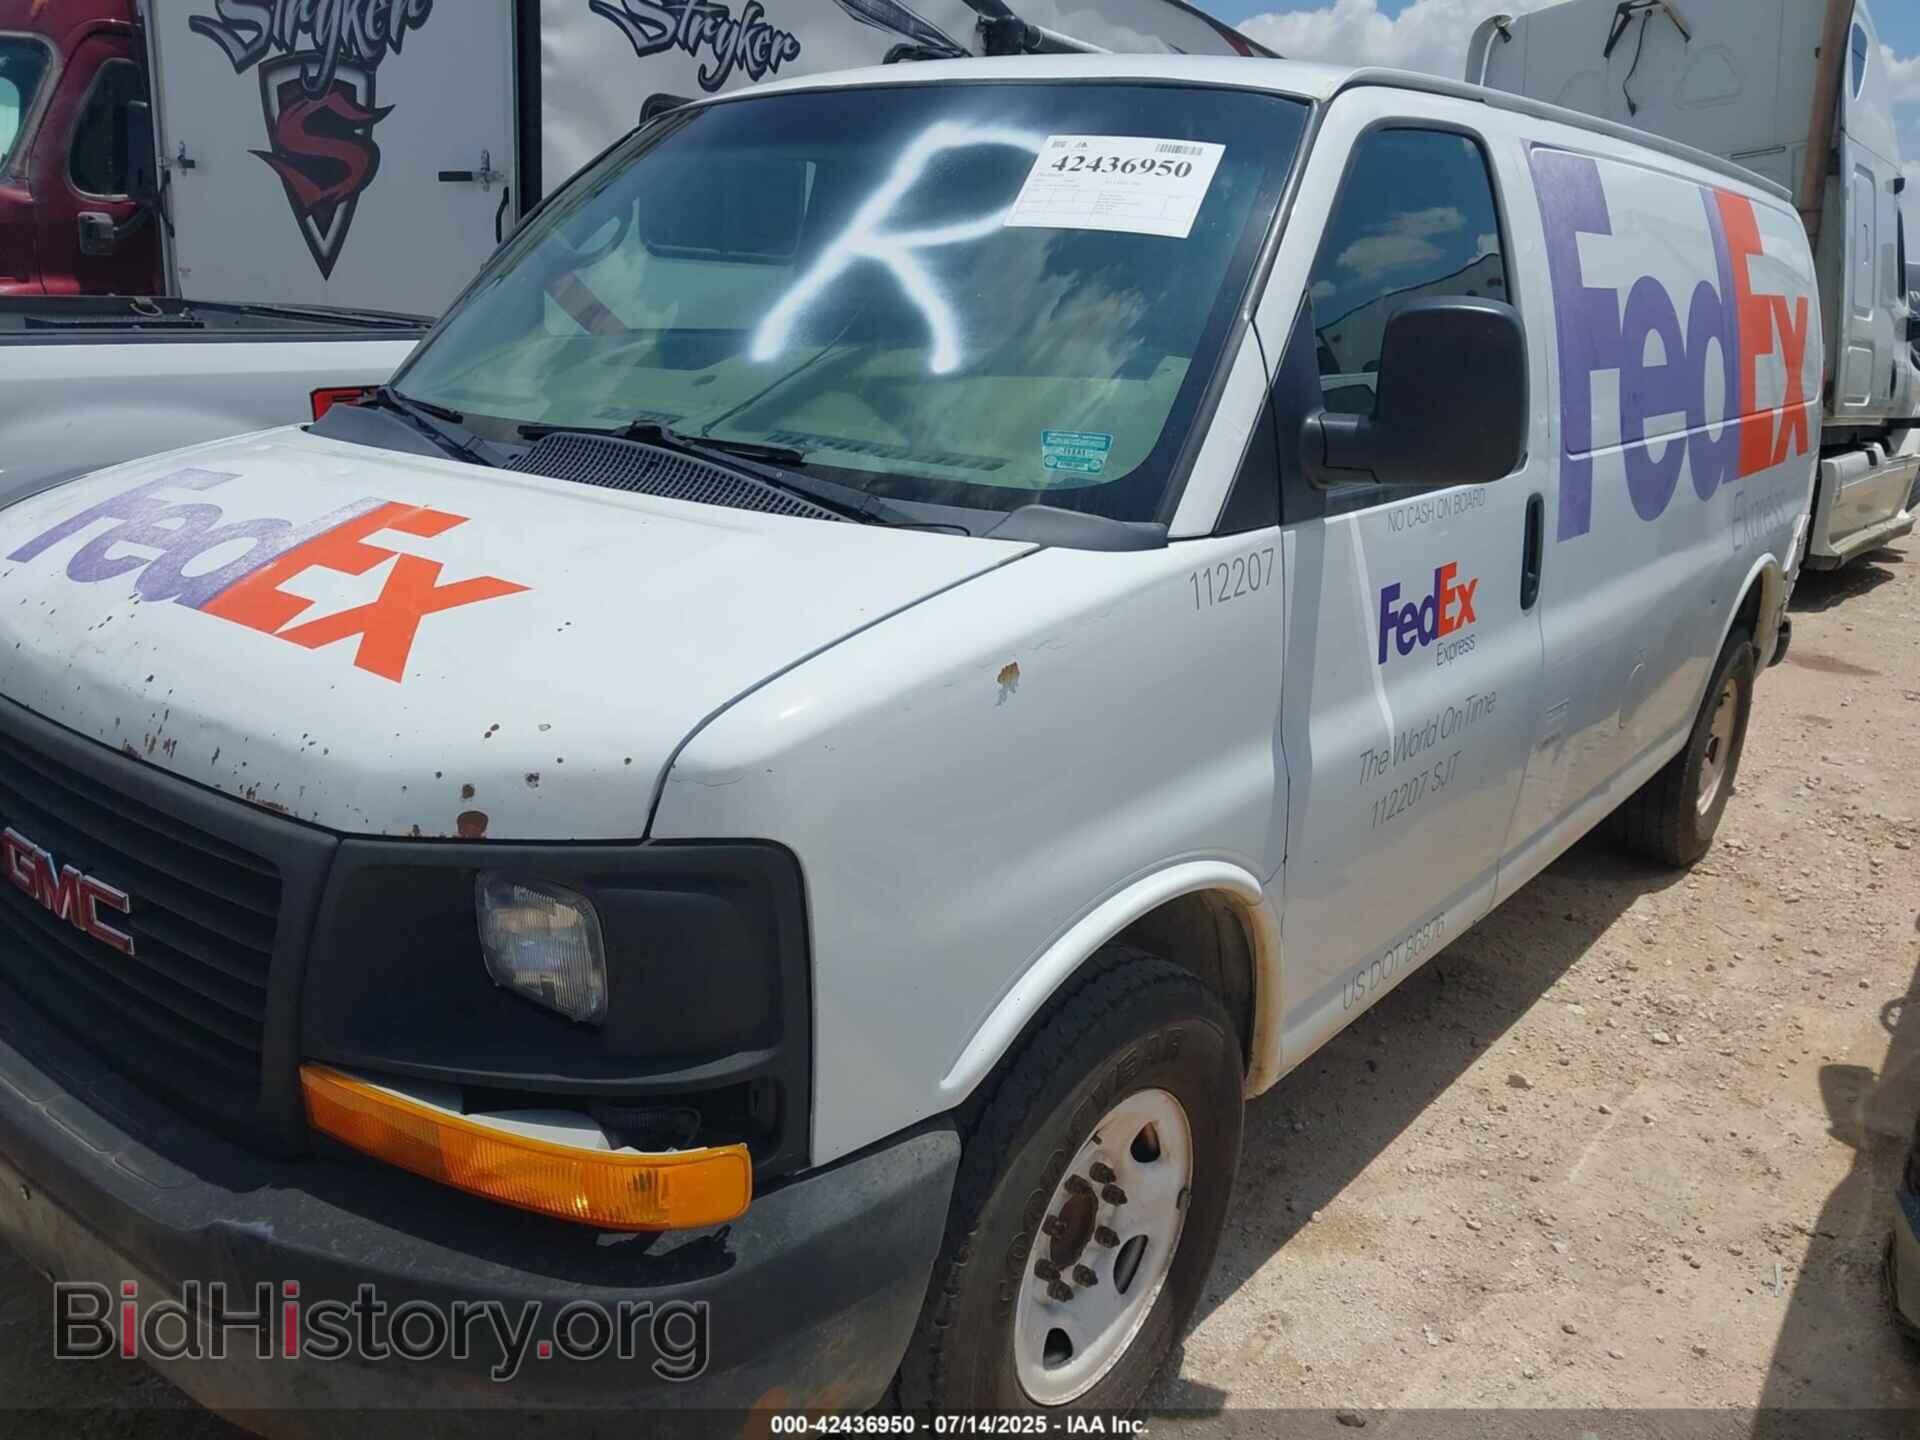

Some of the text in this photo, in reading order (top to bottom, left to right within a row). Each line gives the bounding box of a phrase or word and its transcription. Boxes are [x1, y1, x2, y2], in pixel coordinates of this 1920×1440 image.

[589, 0, 801, 92] Stryker
[1051, 155, 1193, 178] 42436950
[1520, 137, 1809, 542] FedEx
[1387, 487, 1487, 533] NO CASH ON BOARD
[5, 467, 533, 684] FedEx
[1190, 547, 1274, 611] 112207
[1378, 560, 1479, 665] FedEx
[1436, 634, 1477, 667] Express
[1359, 691, 1497, 785] The World On Time
[1370, 750, 1463, 829] 112207 SJT
[0, 826, 136, 957] GMC
[1343, 969, 1366, 1010] US
[1369, 941, 1404, 991] DOT
